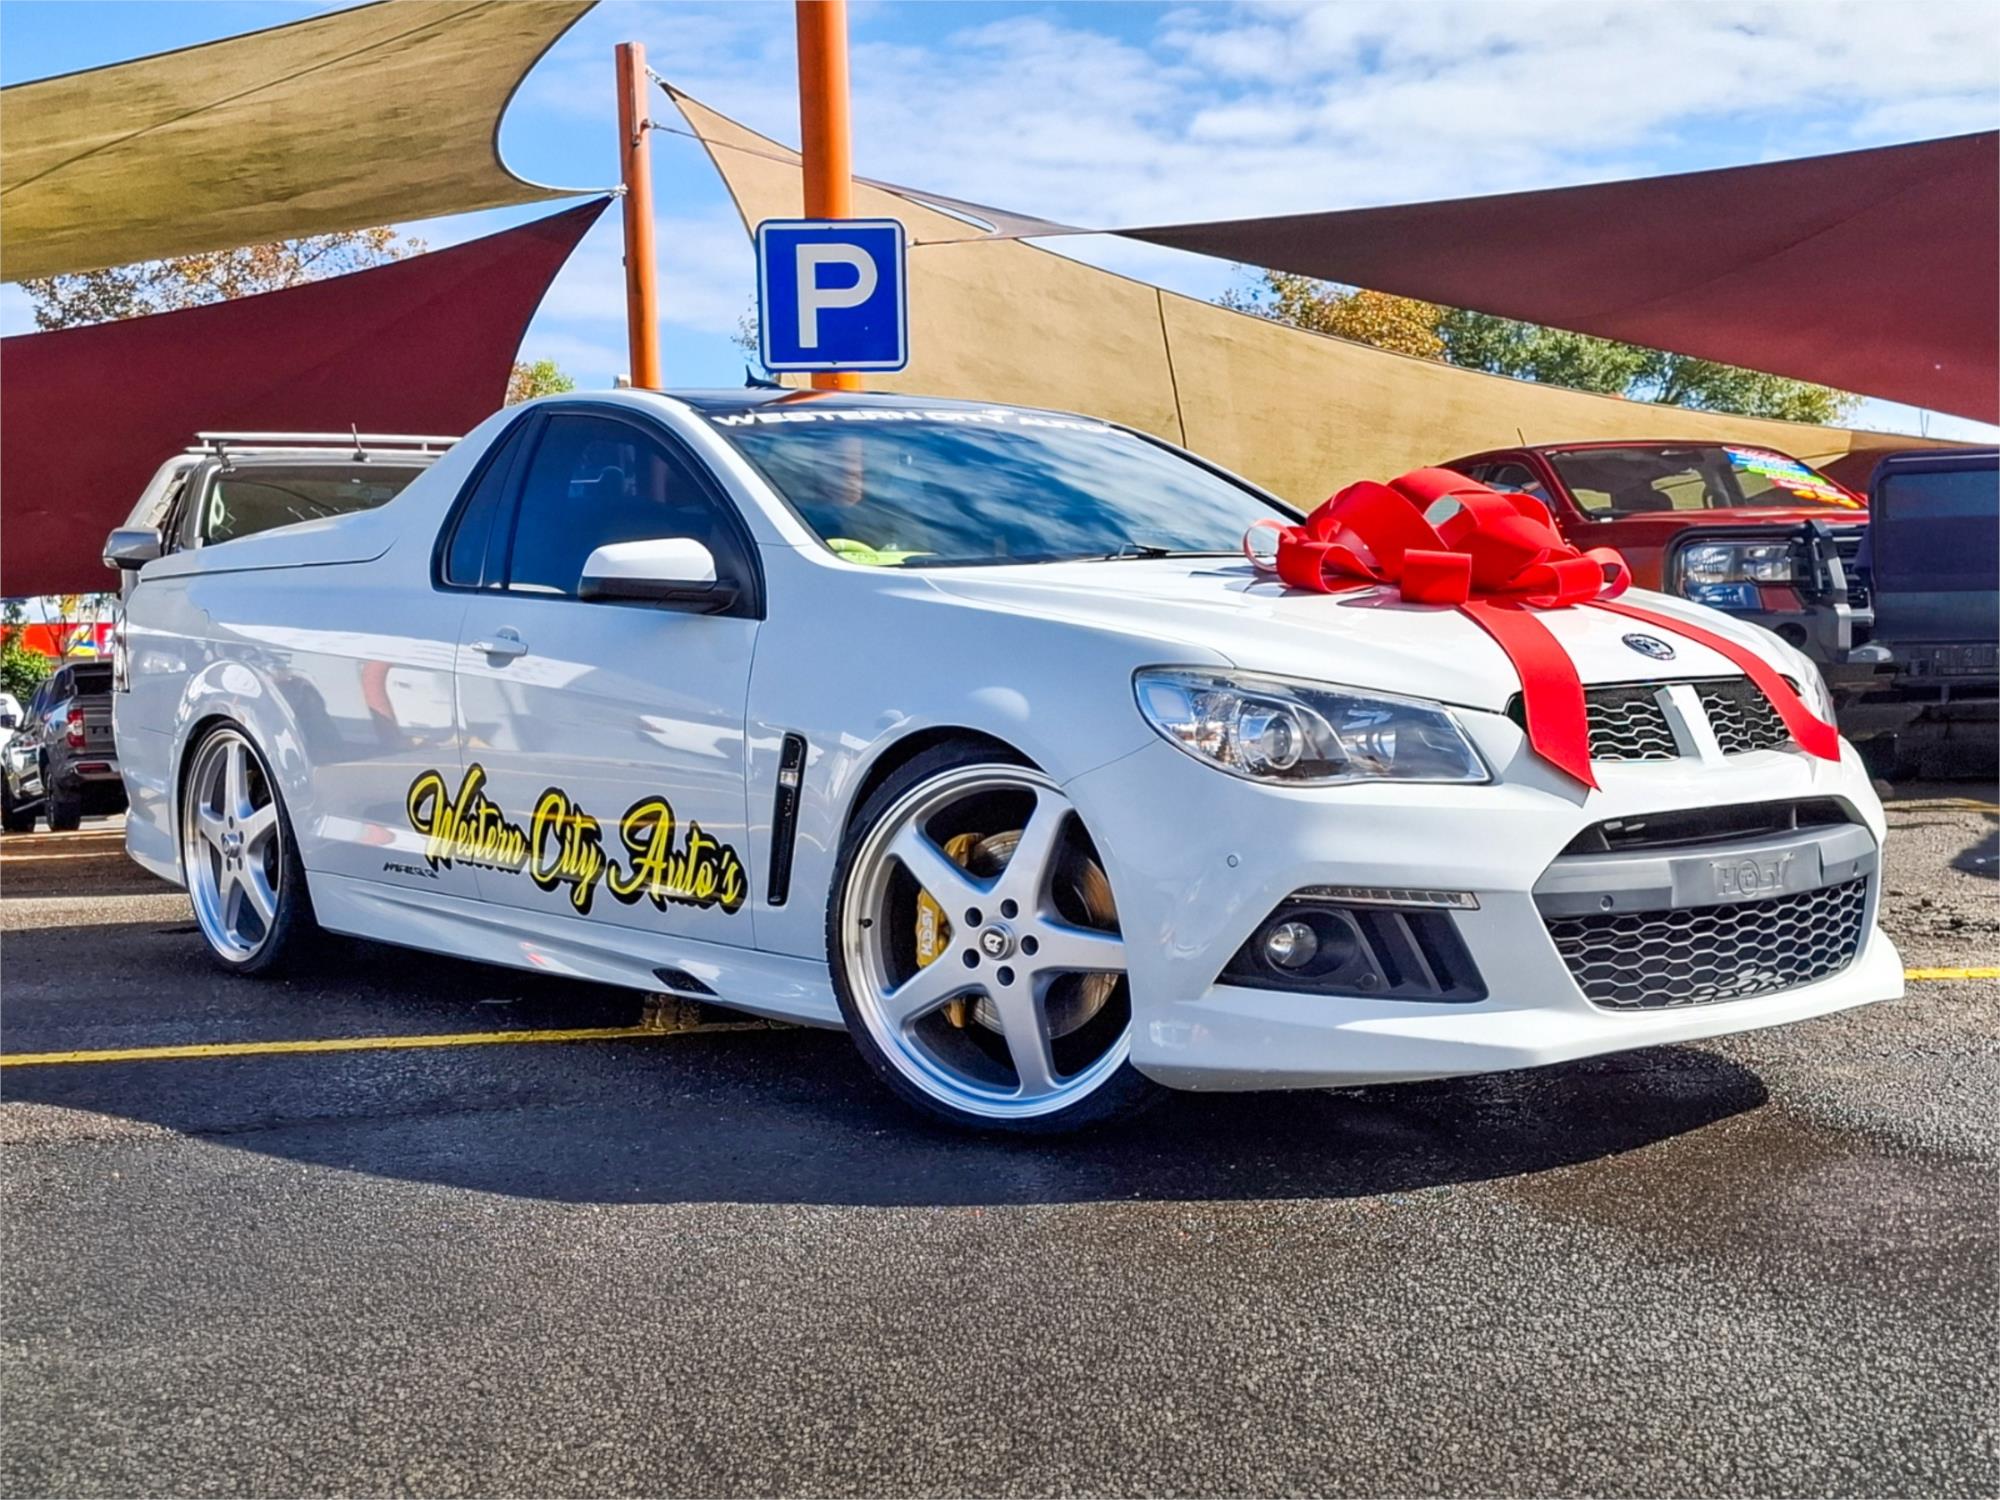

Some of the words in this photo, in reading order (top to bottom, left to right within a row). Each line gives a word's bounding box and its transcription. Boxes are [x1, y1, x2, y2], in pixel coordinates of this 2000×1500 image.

[796, 243, 878, 348] P
[711, 410, 923, 426] WESTERN
[408, 763, 528, 872] Western
[530, 788, 605, 913] City
[607, 797, 747, 913] Auto's
